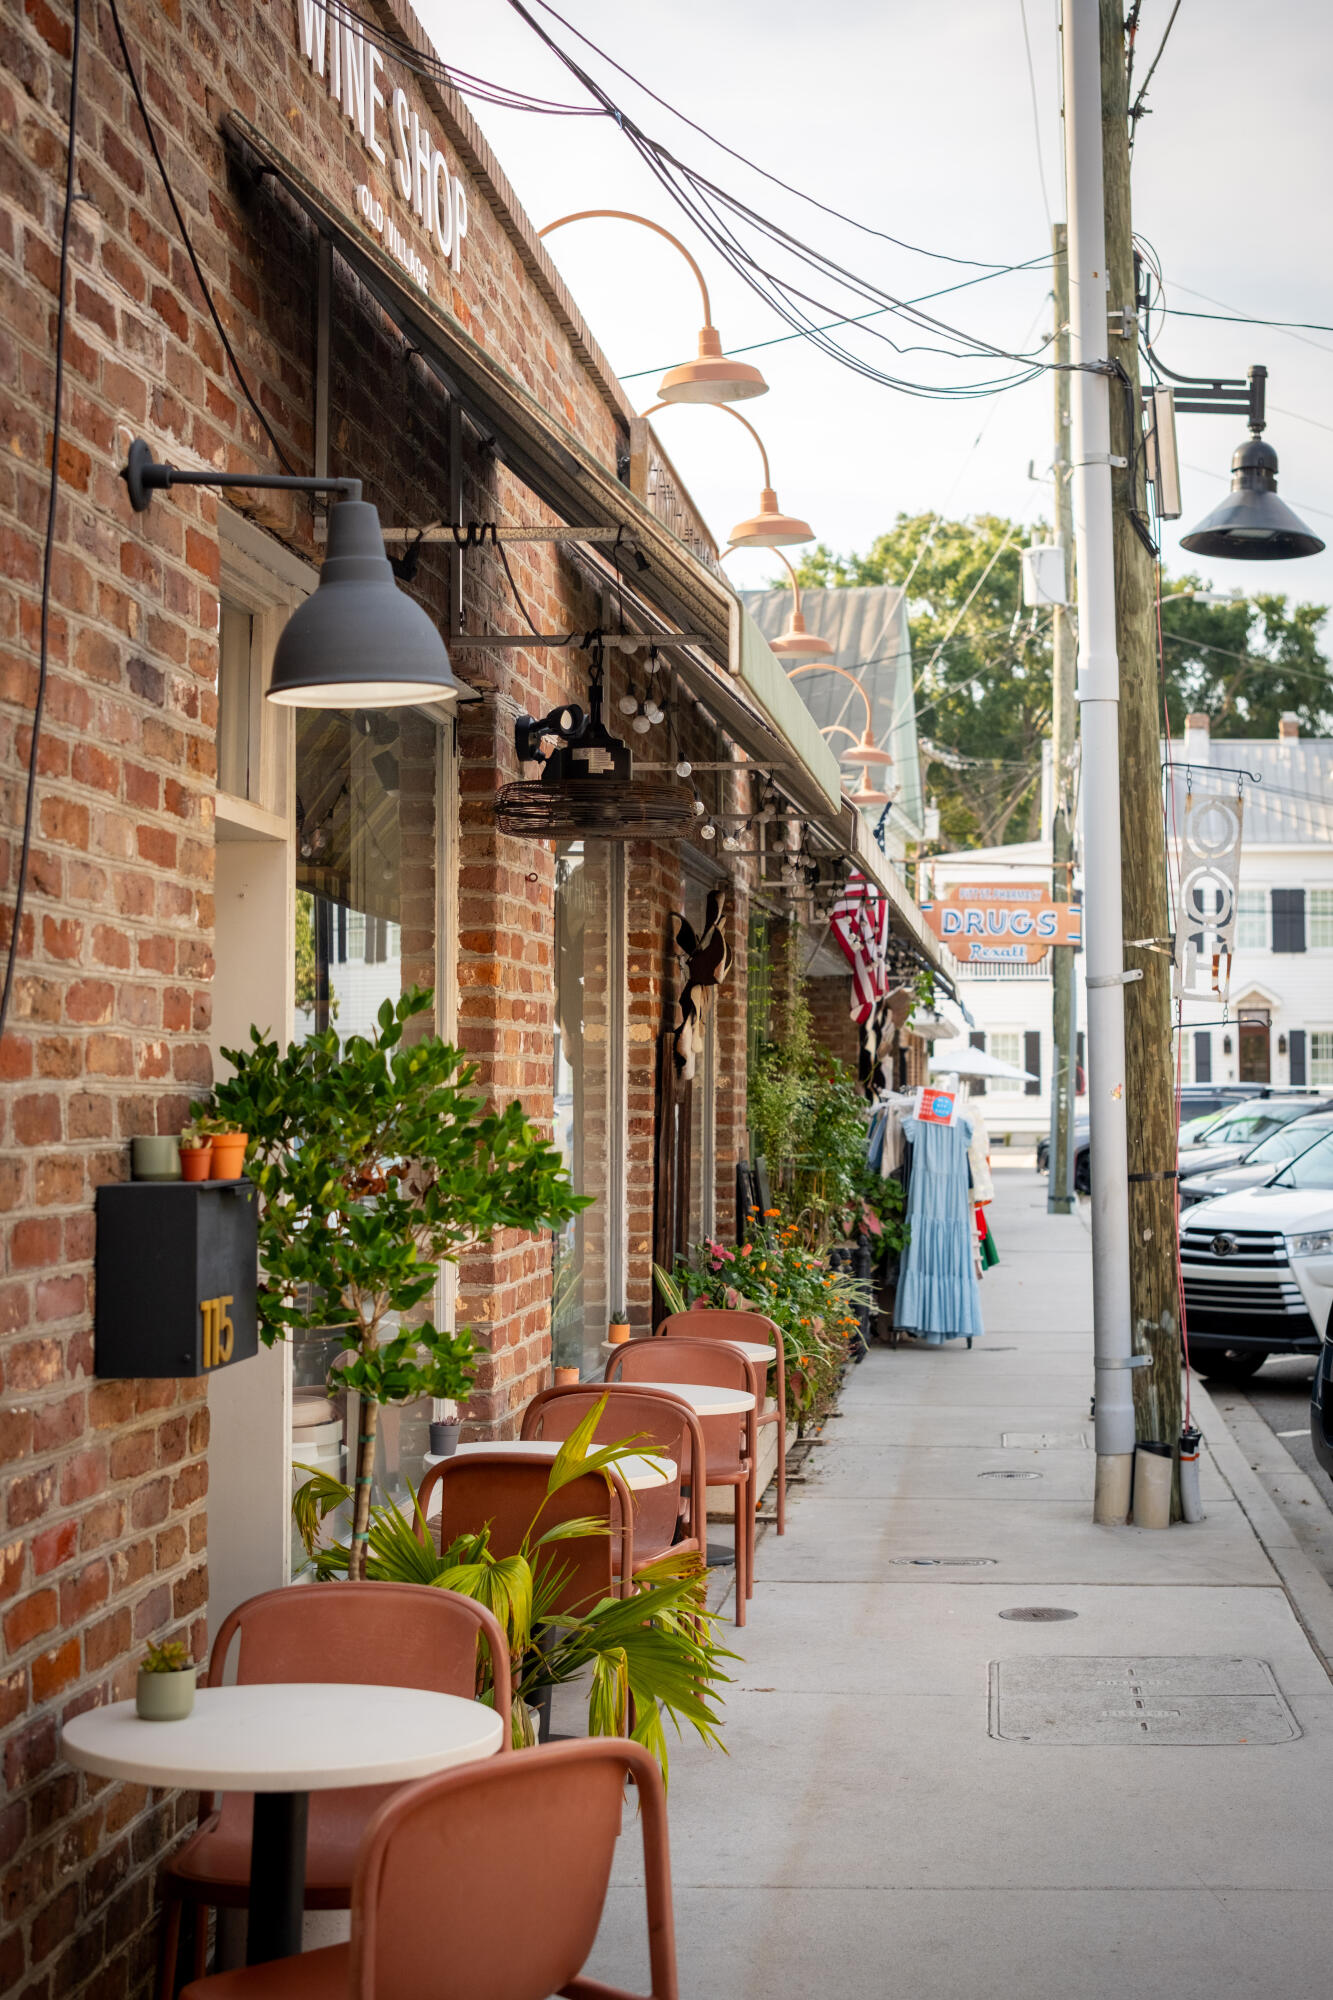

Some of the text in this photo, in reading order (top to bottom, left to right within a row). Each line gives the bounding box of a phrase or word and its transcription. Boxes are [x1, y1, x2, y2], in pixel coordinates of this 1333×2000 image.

[299, 0, 468, 274] WINE SHOP
[357, 184, 429, 295] OLD VILLAGE
[942, 908, 1057, 937] DRUGS
[969, 943, 1028, 961] Rexall
[200, 1295, 235, 1368] 115
